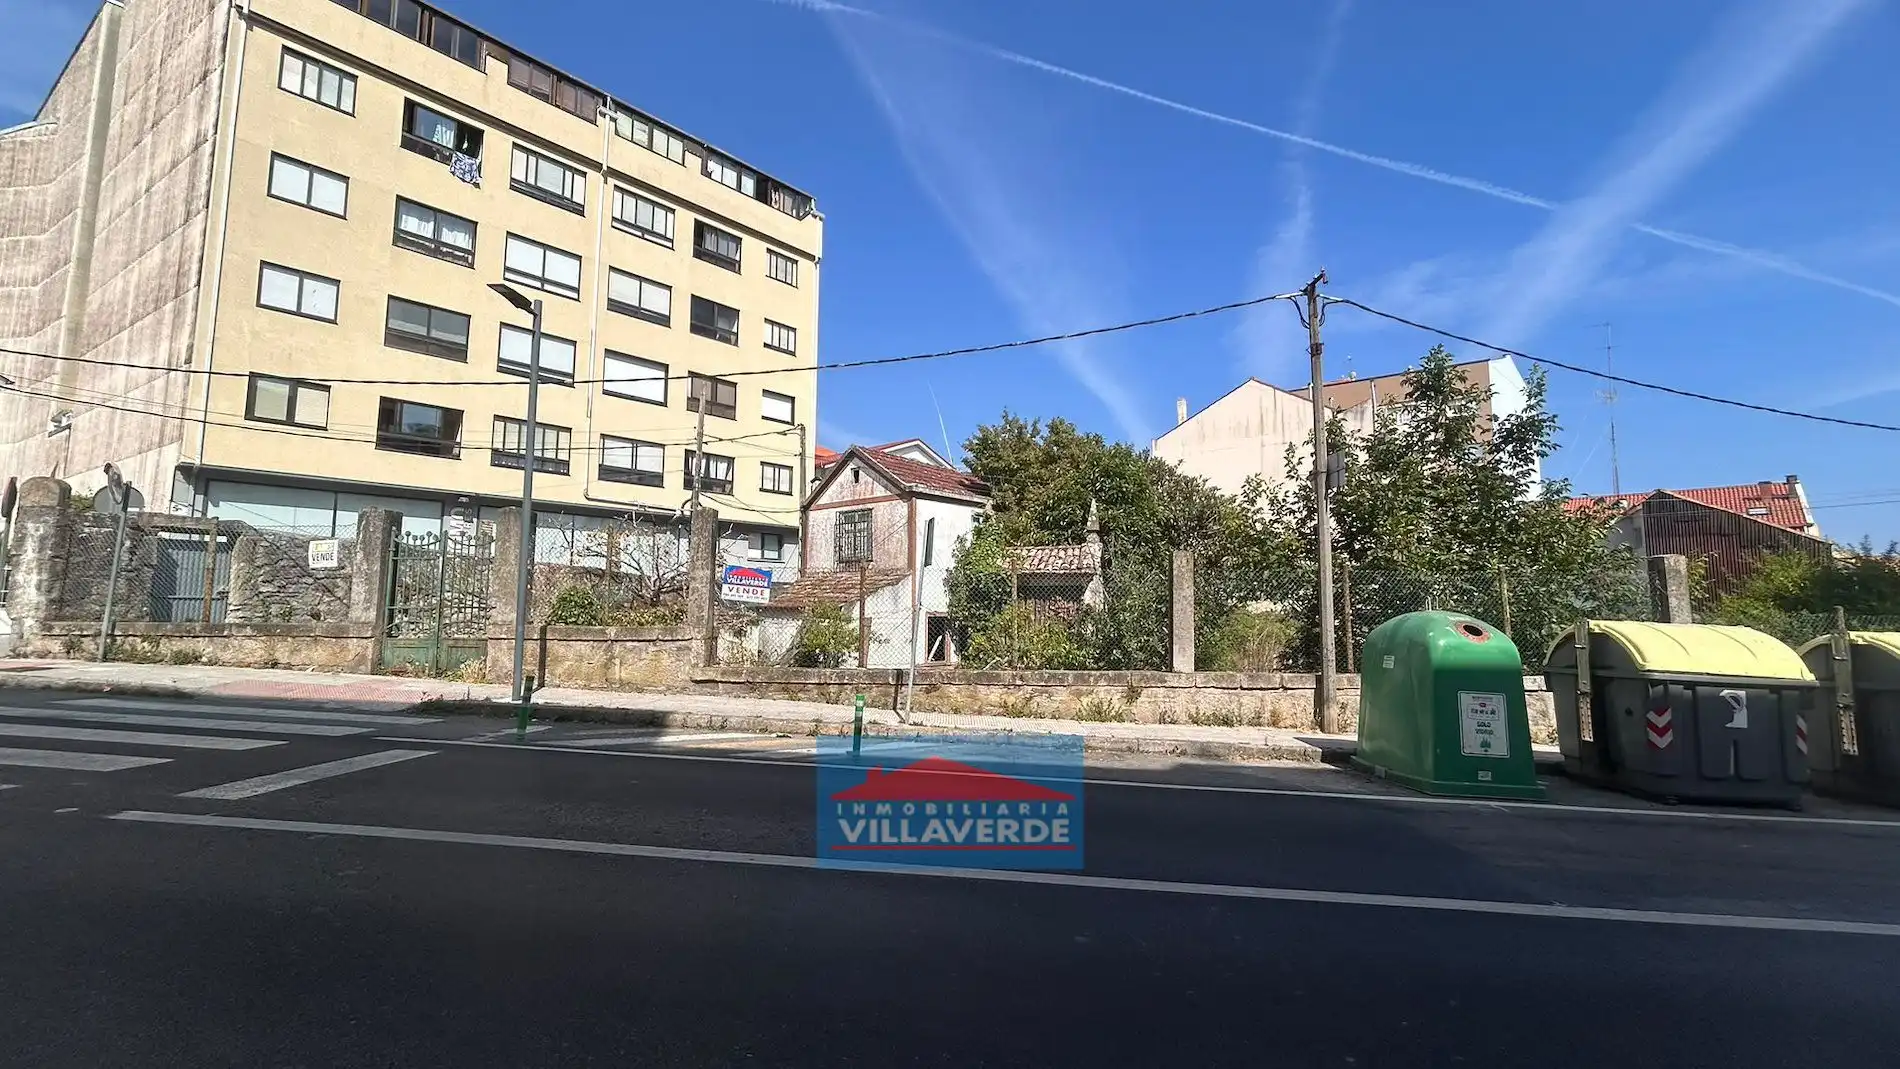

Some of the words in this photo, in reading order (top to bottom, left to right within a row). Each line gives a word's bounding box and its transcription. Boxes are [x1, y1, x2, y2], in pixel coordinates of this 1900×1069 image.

[312, 552, 334, 562] VENDE
[727, 577, 769, 587] VILLAVERDE
[728, 586, 765, 596] VENDE
